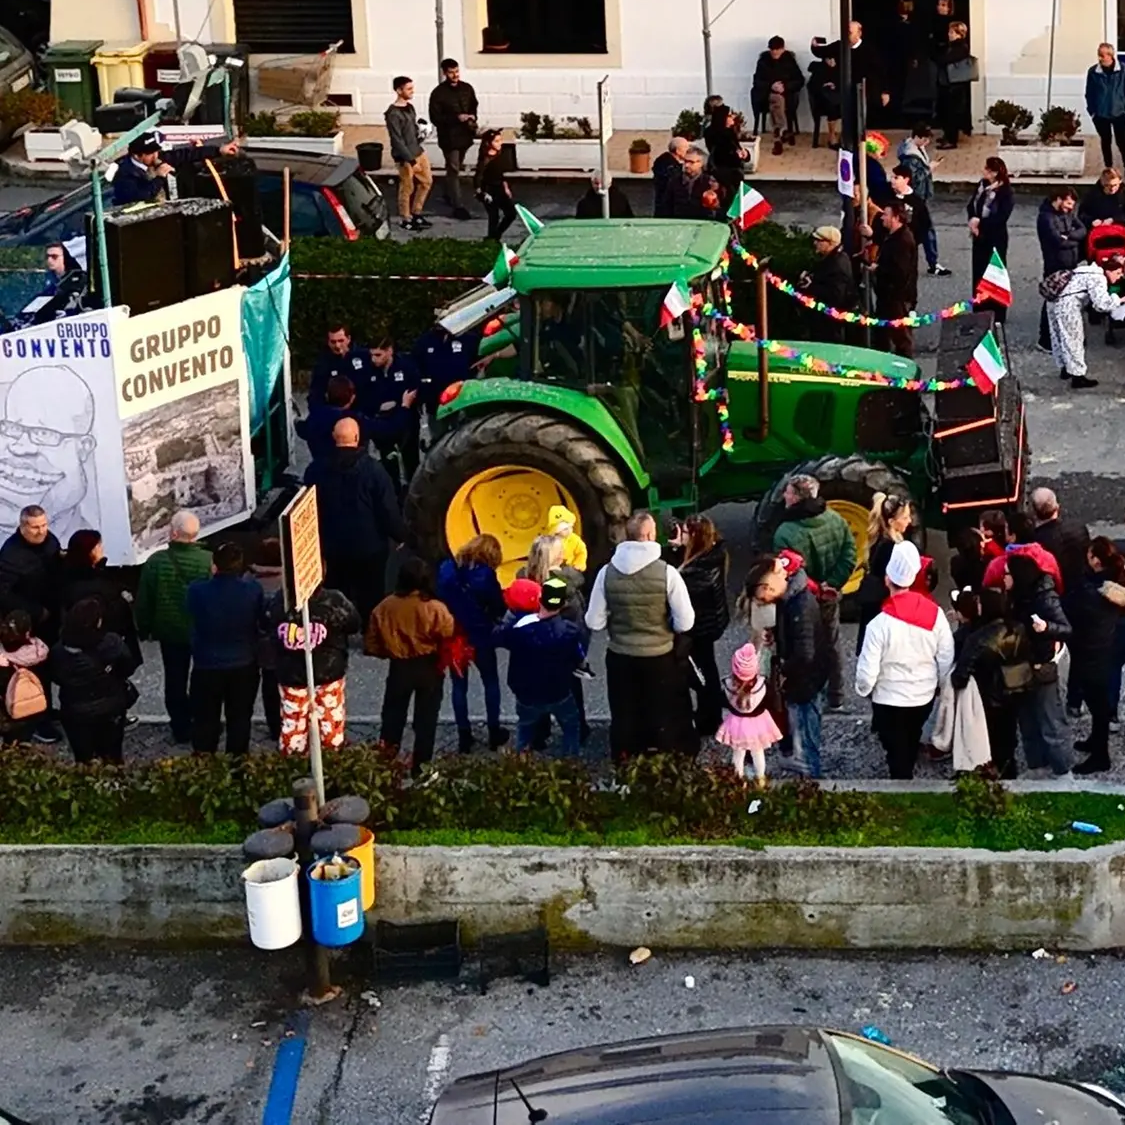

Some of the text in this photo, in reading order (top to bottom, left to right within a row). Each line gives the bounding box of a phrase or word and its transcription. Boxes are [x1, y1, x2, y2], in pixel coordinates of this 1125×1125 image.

[57, 323, 108, 338] GRUPPO
[130, 315, 221, 363] GRUPPO
[3, 338, 111, 358] CONVENTO
[121, 345, 233, 402] CONVENTO
